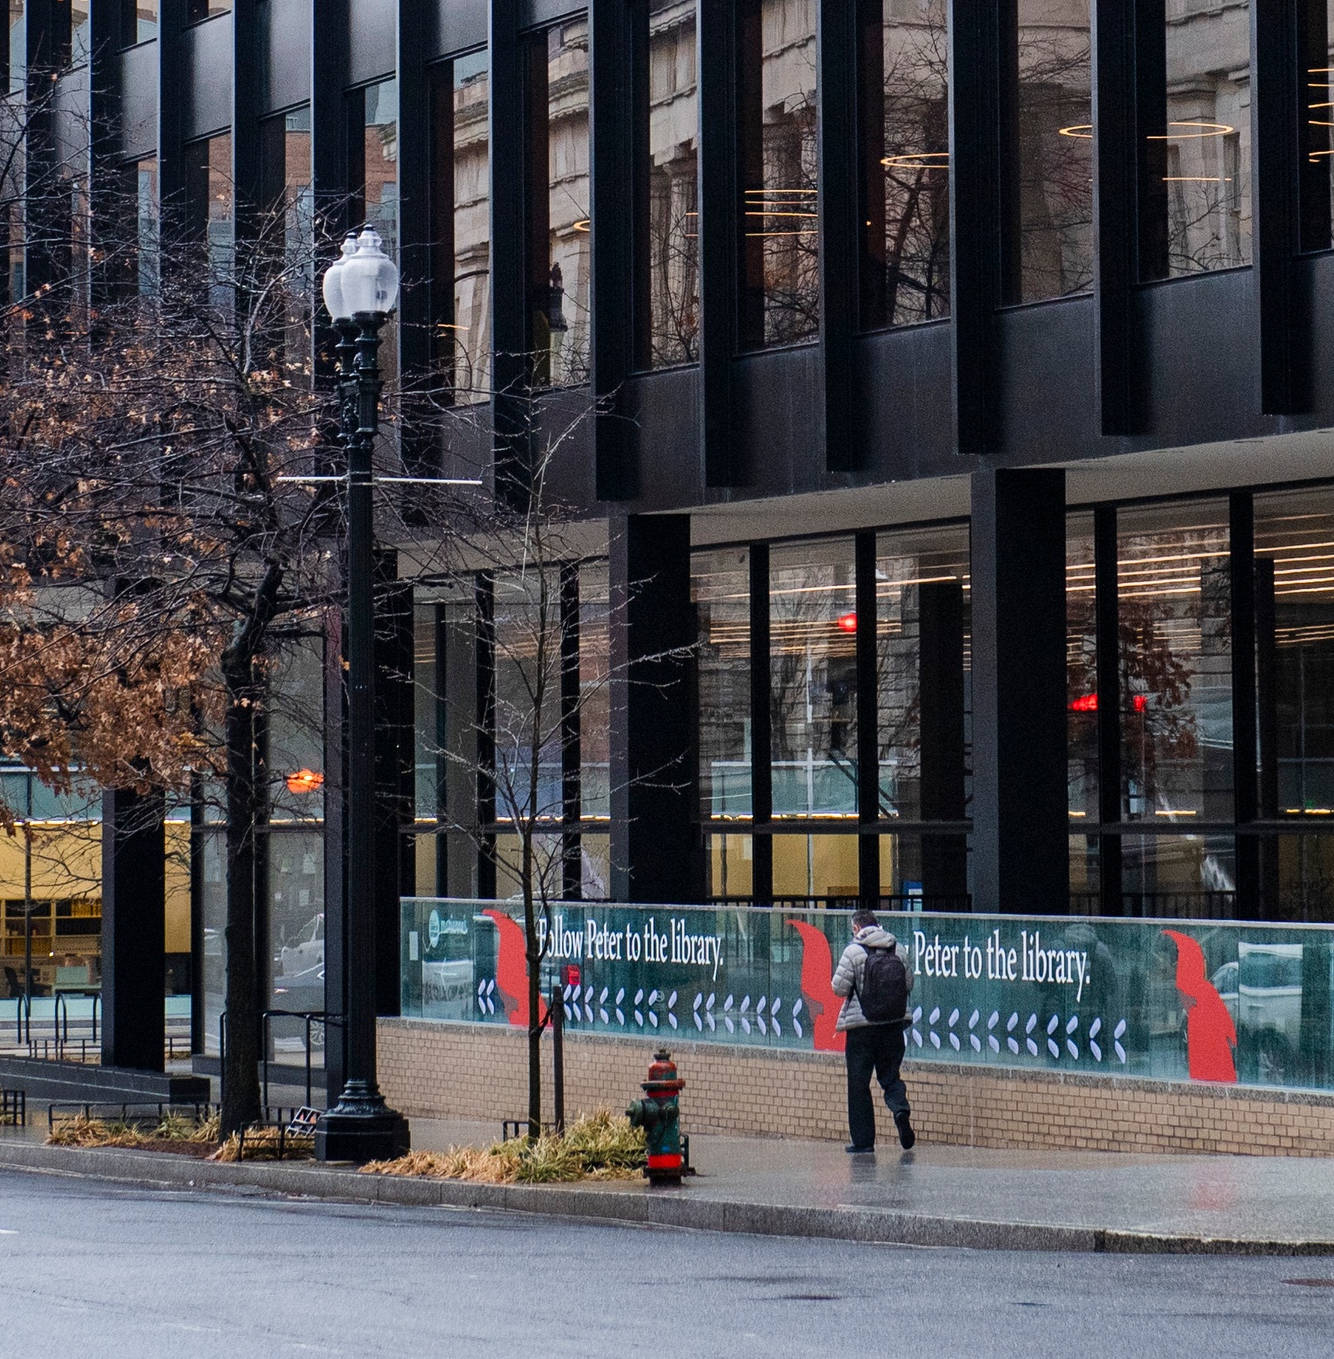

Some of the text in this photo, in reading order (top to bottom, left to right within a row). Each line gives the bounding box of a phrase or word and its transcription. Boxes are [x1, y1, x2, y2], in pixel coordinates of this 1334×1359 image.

[587, 918, 623, 961] Peter
[626, 923, 641, 962] to
[643, 916, 668, 964] the
[670, 918, 724, 983] library.
[913, 928, 1091, 1003] Peter to the library.
